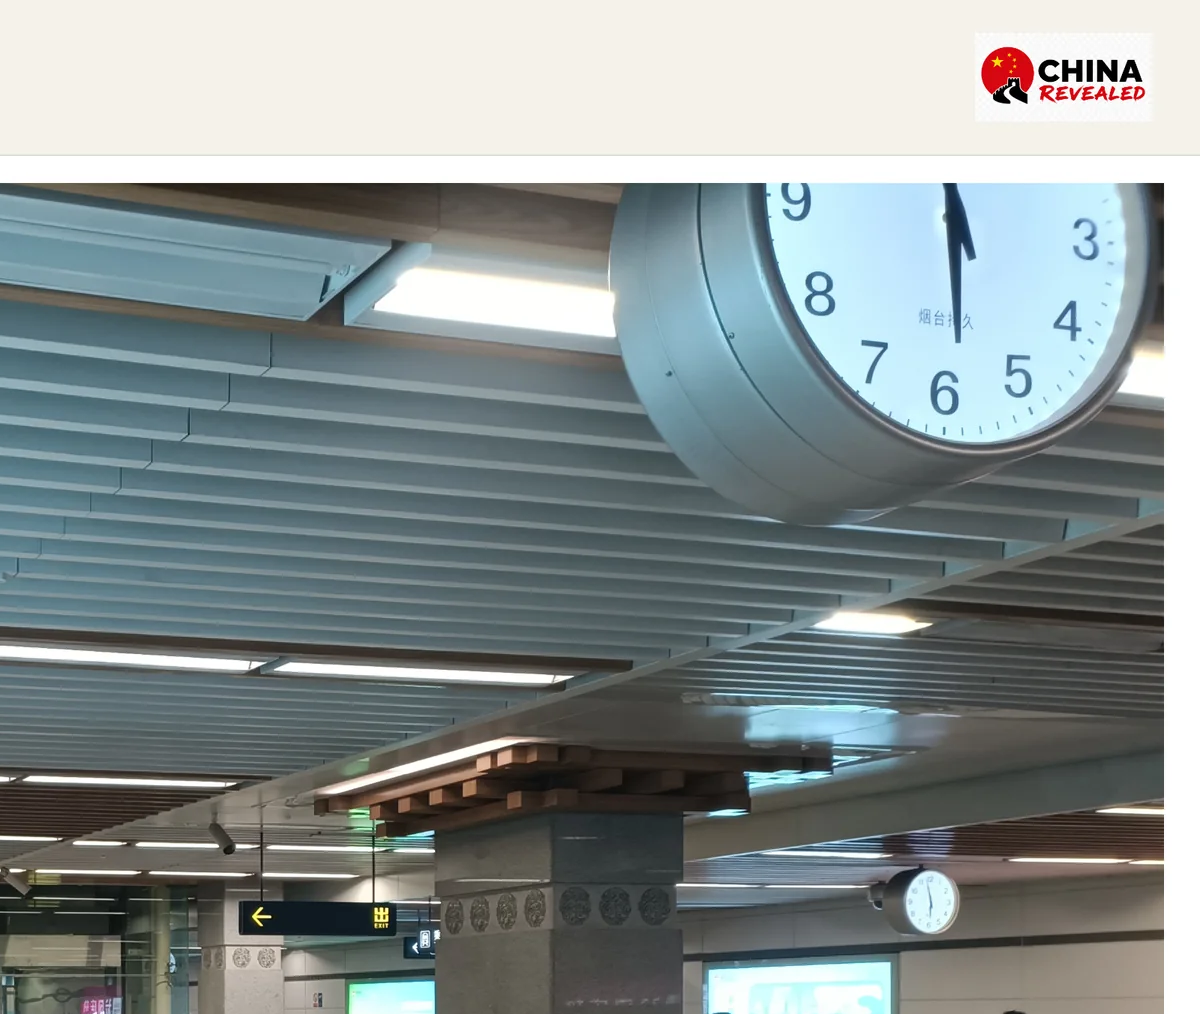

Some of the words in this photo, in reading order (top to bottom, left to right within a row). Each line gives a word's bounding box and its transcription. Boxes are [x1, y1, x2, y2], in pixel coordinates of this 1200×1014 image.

[781, 183, 812, 222] 9
[1073, 217, 1099, 261] 3
[805, 271, 836, 316] 8
[1053, 300, 1082, 342] 4
[861, 340, 889, 384] 7
[1004, 354, 1032, 398] 5
[931, 371, 959, 415] 6
